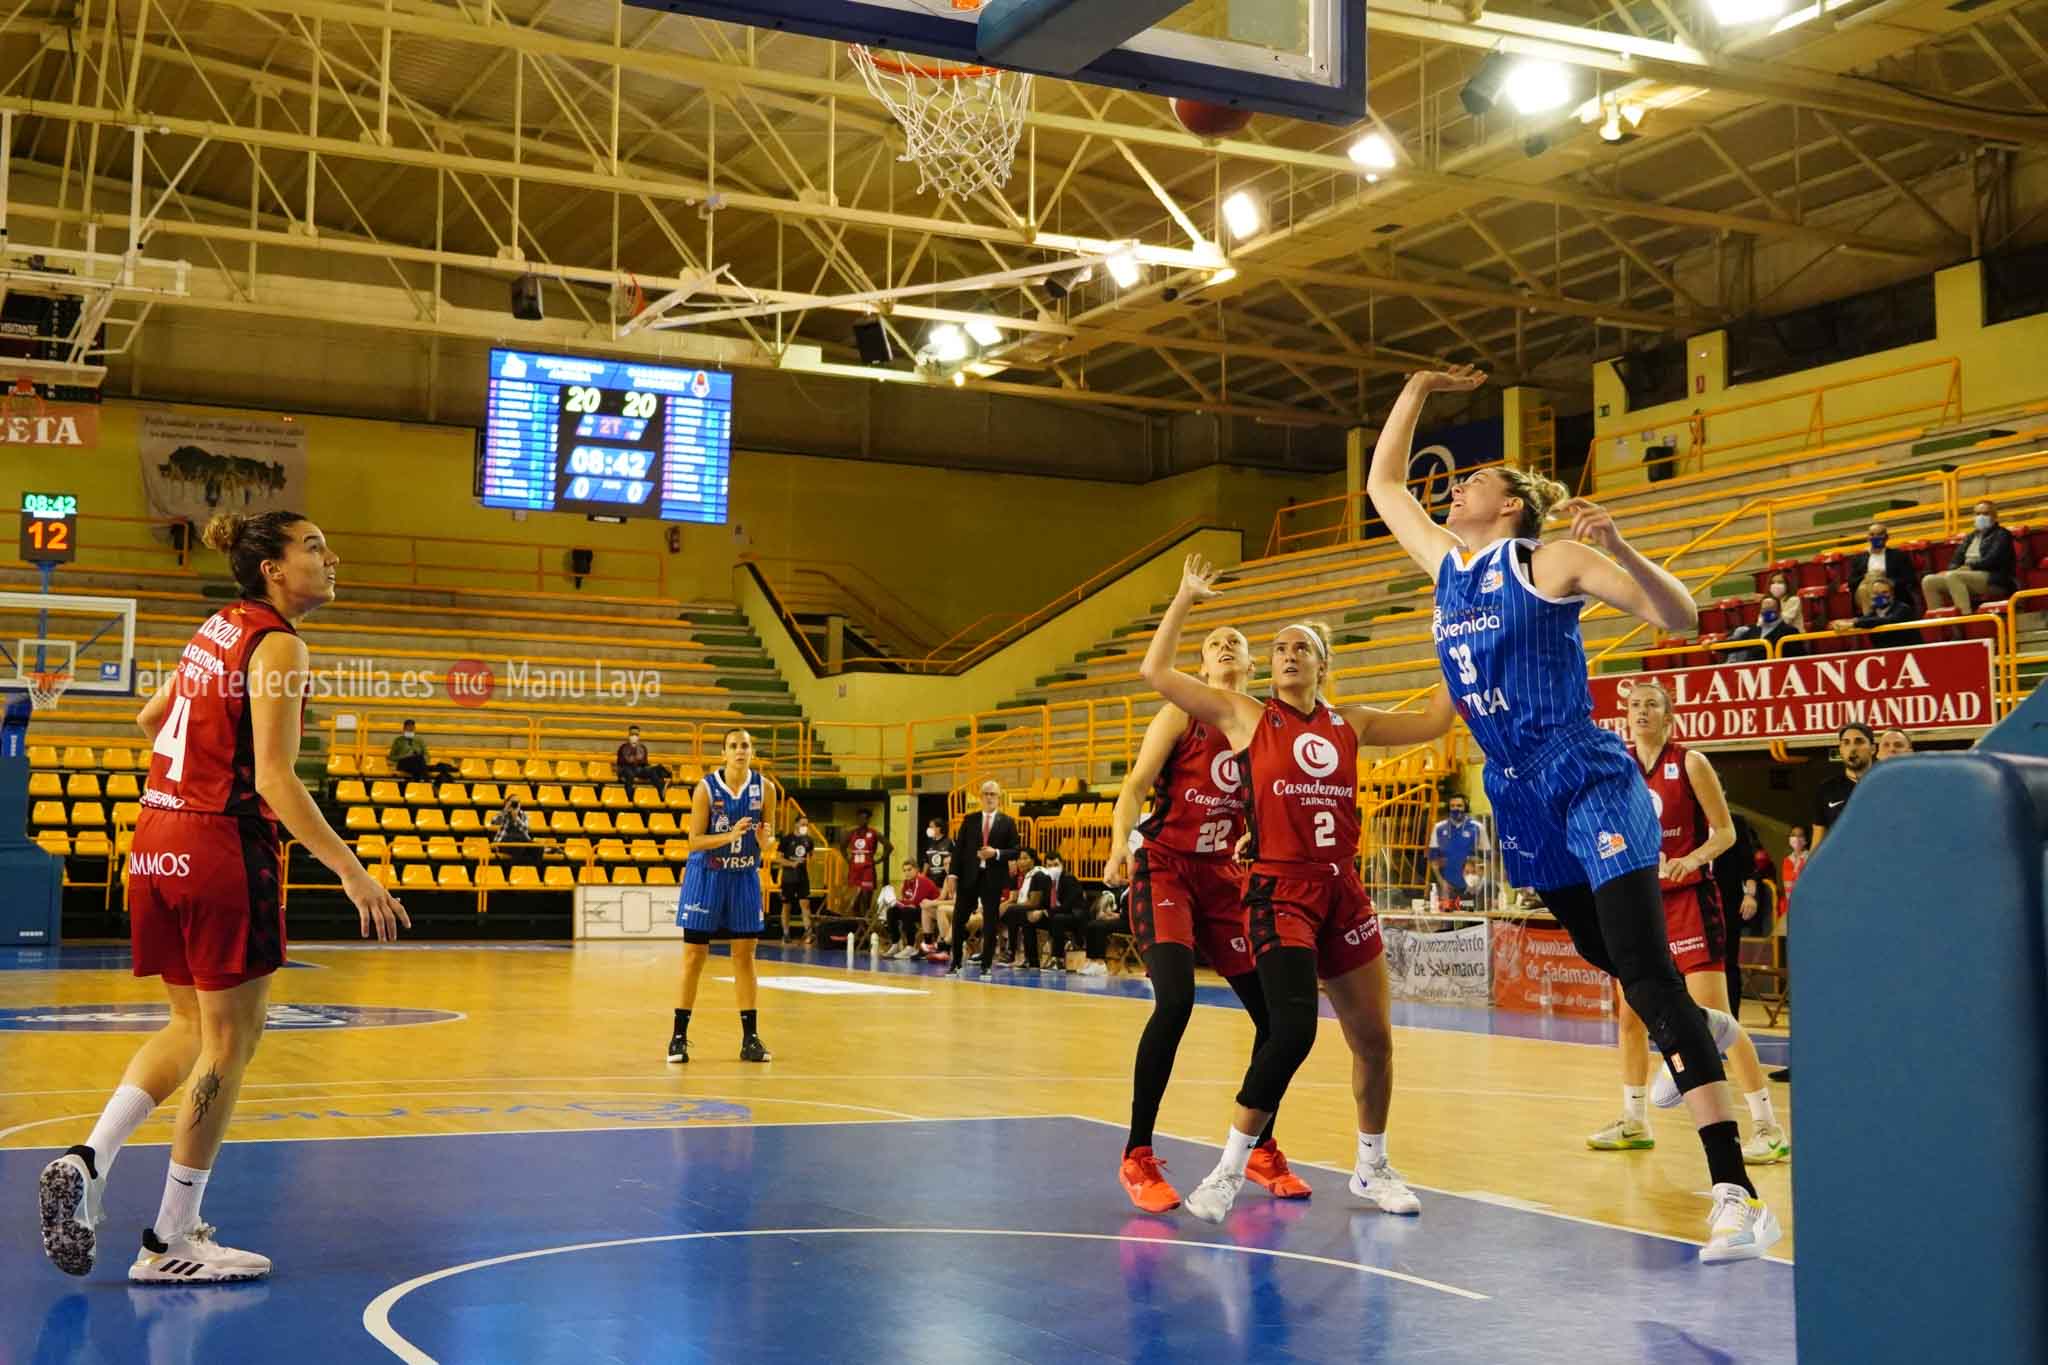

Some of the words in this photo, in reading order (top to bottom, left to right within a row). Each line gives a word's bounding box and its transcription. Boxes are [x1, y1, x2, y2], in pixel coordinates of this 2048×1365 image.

[566, 386, 600, 413] 20
[622, 391, 657, 418] 20
[571, 448, 646, 478] 08:42
[25, 494, 76, 514] 08:42
[28, 521, 67, 549] 12
[1449, 643, 1478, 686] 33
[1616, 652, 1930, 711] SLAMANCA
[1722, 707, 1758, 736] DE
[1765, 704, 1797, 735] LA
[1804, 691, 1982, 732] HUMANIDAD
[153, 695, 192, 782] 4
[1195, 819, 1233, 853] 22
[1314, 810, 1336, 847] 2
